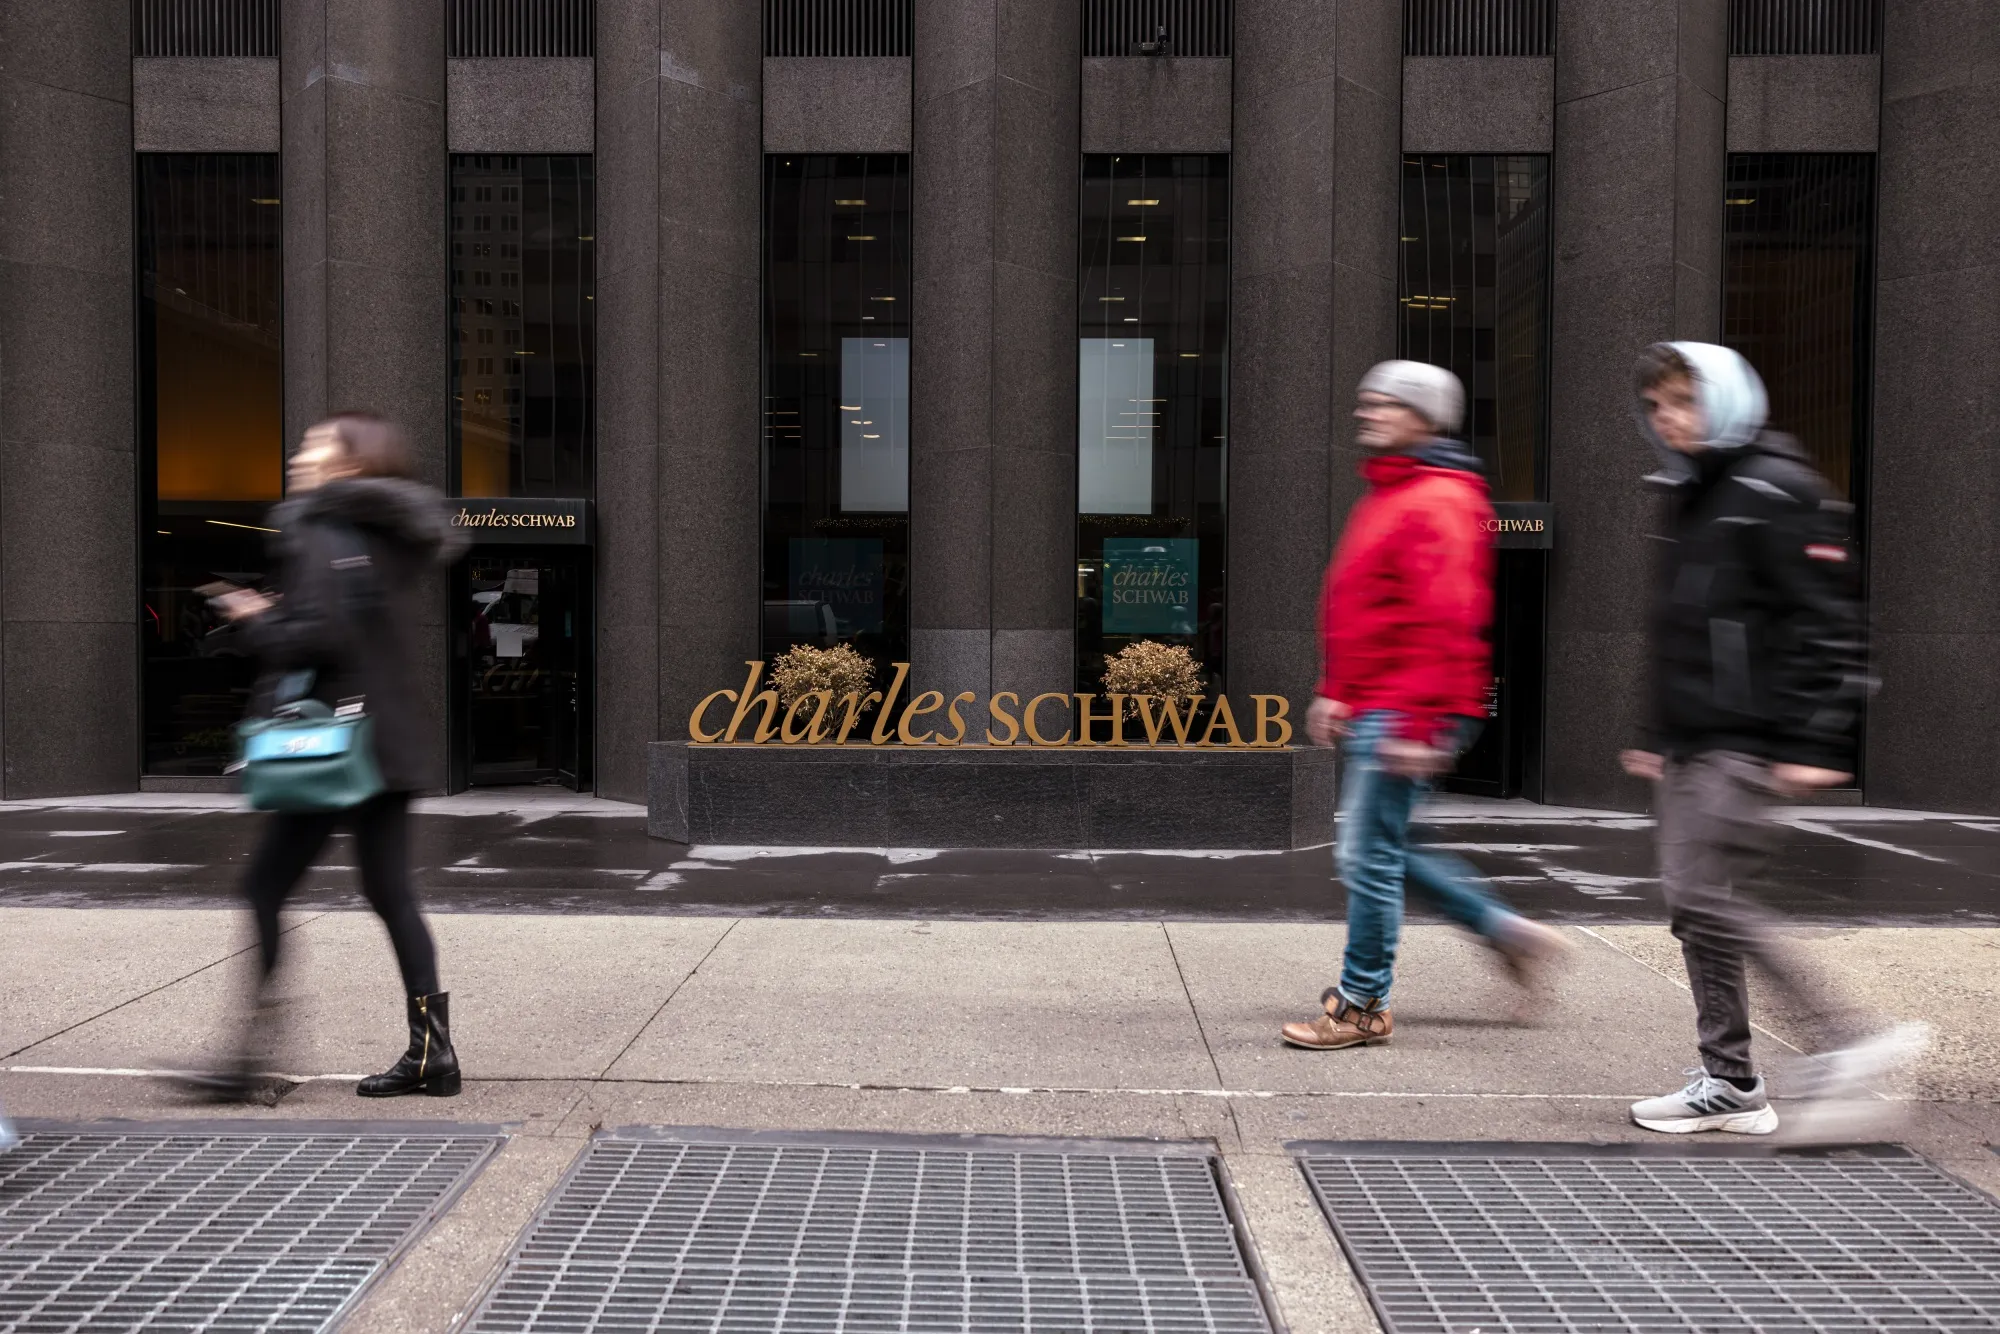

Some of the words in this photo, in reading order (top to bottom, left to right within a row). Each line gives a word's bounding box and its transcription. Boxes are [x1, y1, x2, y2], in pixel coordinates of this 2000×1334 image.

[450, 508, 510, 527] charles
[511, 514, 575, 527] SCHWAB
[1478, 519, 1544, 532] SCHWAB
[1112, 564, 1188, 587] charles
[1112, 590, 1188, 604] SCHWAB
[687, 660, 975, 744] charles
[986, 692, 1293, 748] SCHWAB
